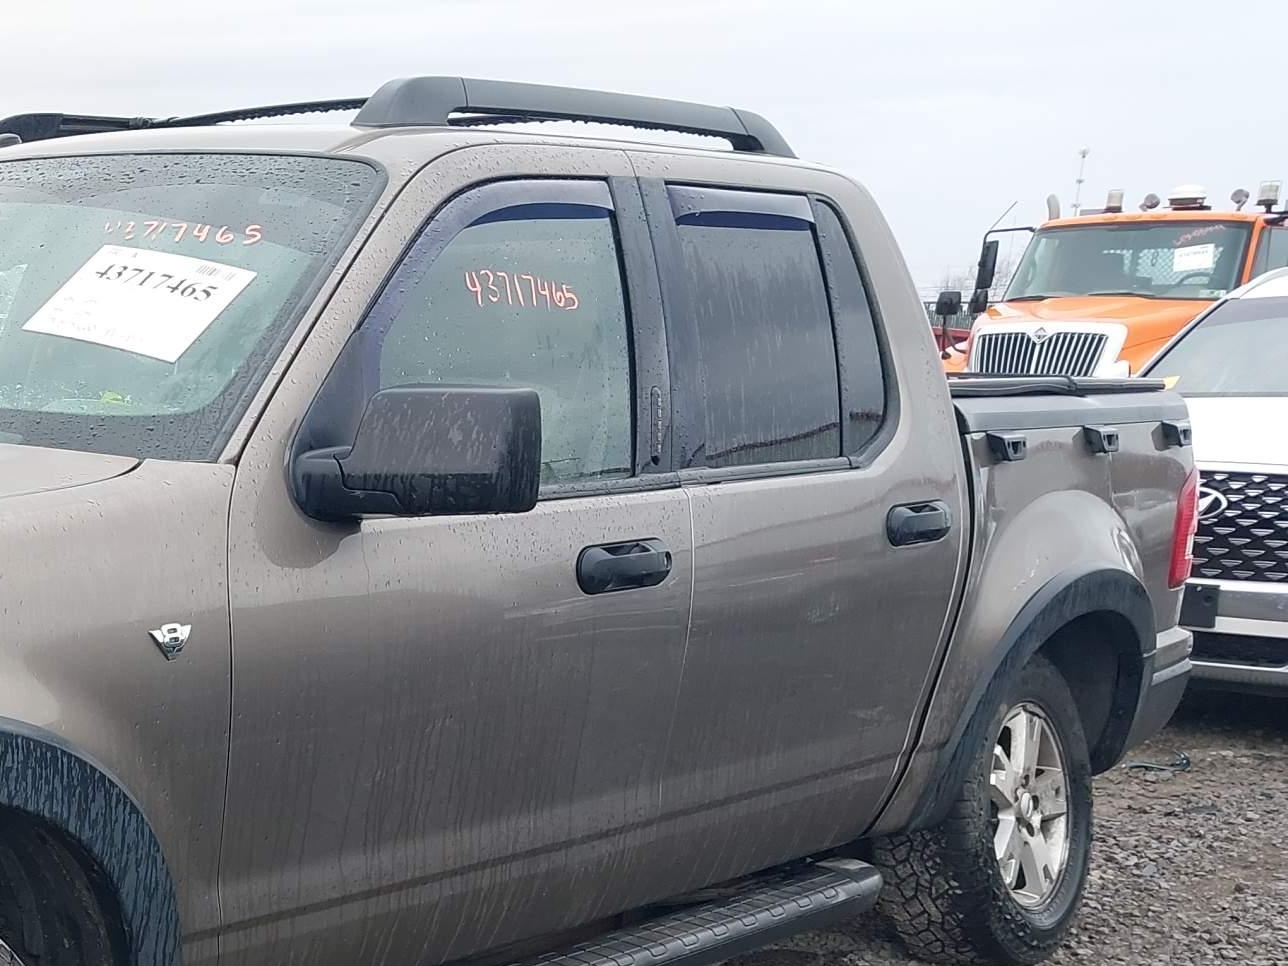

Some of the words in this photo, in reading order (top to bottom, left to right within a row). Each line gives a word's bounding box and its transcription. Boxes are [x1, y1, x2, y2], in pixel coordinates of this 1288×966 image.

[96, 263, 218, 301] 43717465
[464, 268, 580, 312] 43717465
[148, 622, 193, 662] V8
